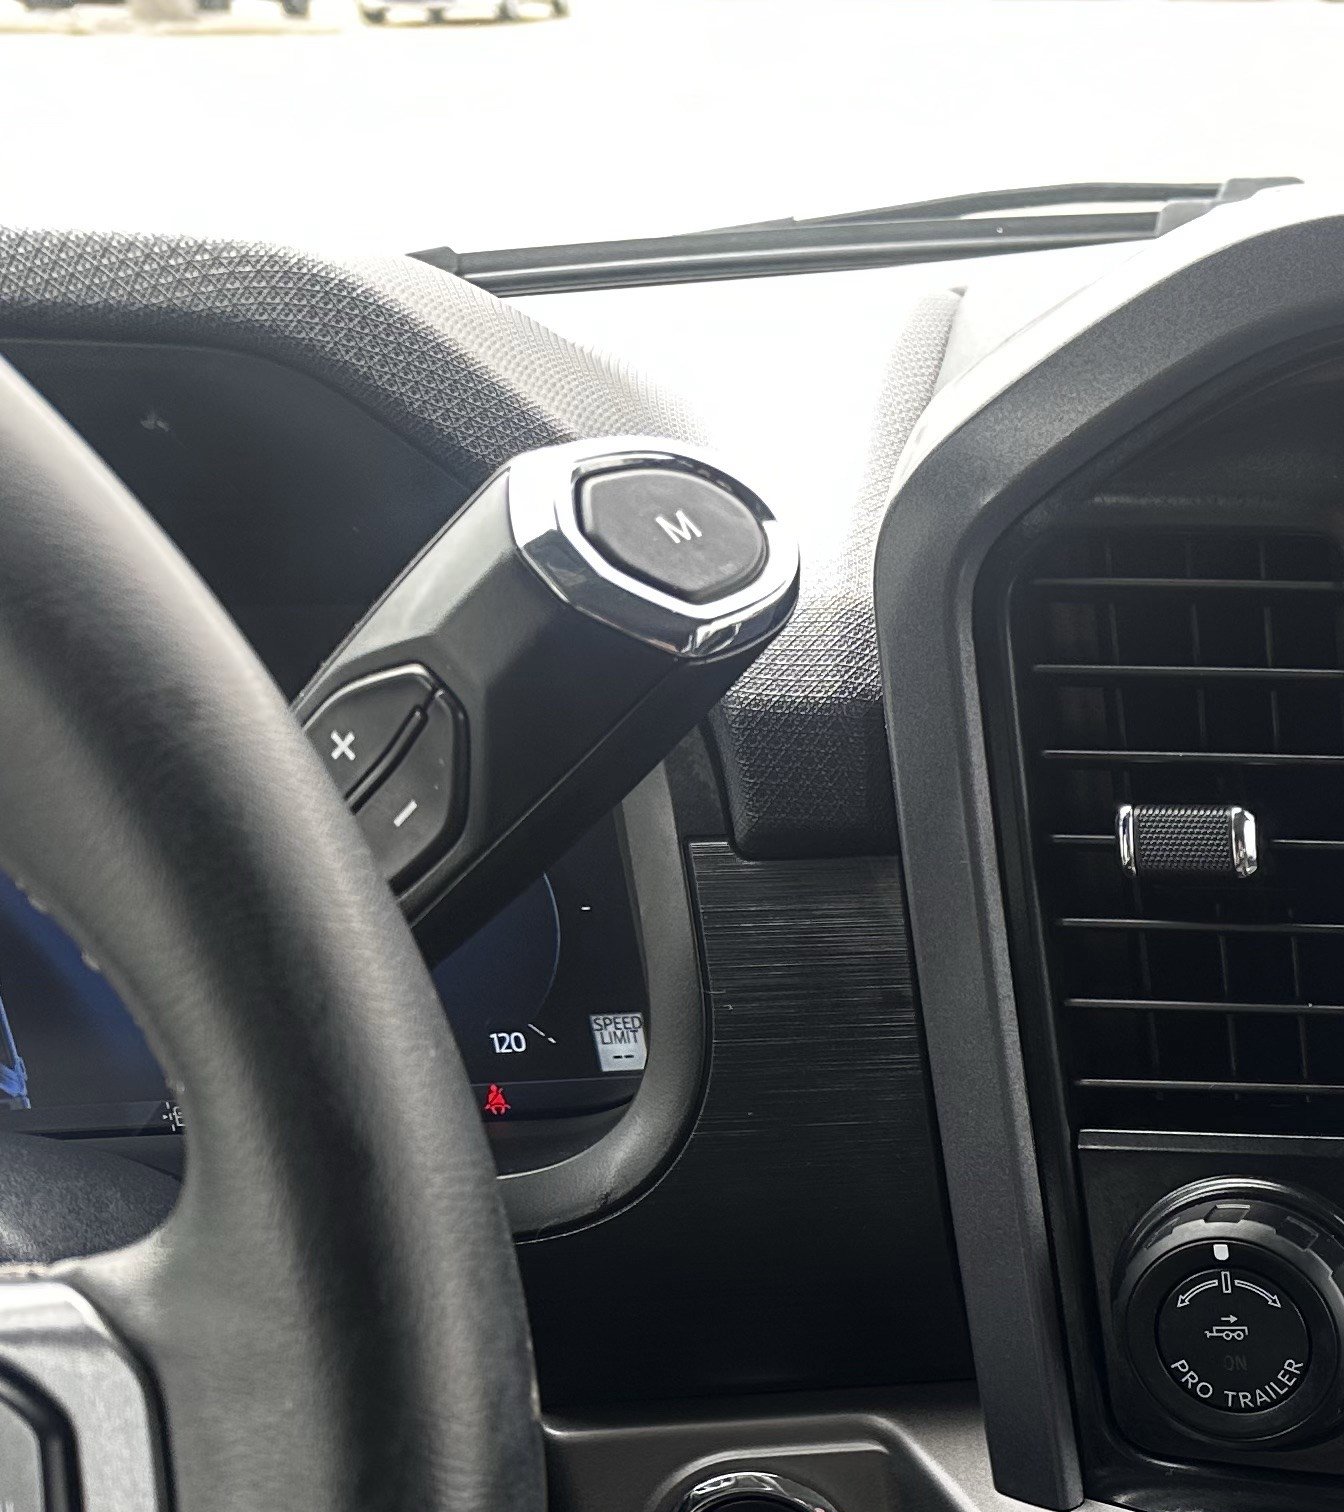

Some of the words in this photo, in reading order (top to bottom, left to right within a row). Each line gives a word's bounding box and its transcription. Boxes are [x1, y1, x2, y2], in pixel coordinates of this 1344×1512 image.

[655, 509, 703, 544] M
[593, 1016, 643, 1032] SPEED
[489, 1031, 527, 1054] 120
[601, 1029, 639, 1045] LIMIT
[1170, 1358, 1213, 1398] PRO
[1223, 1358, 1304, 1408] TRAILER
